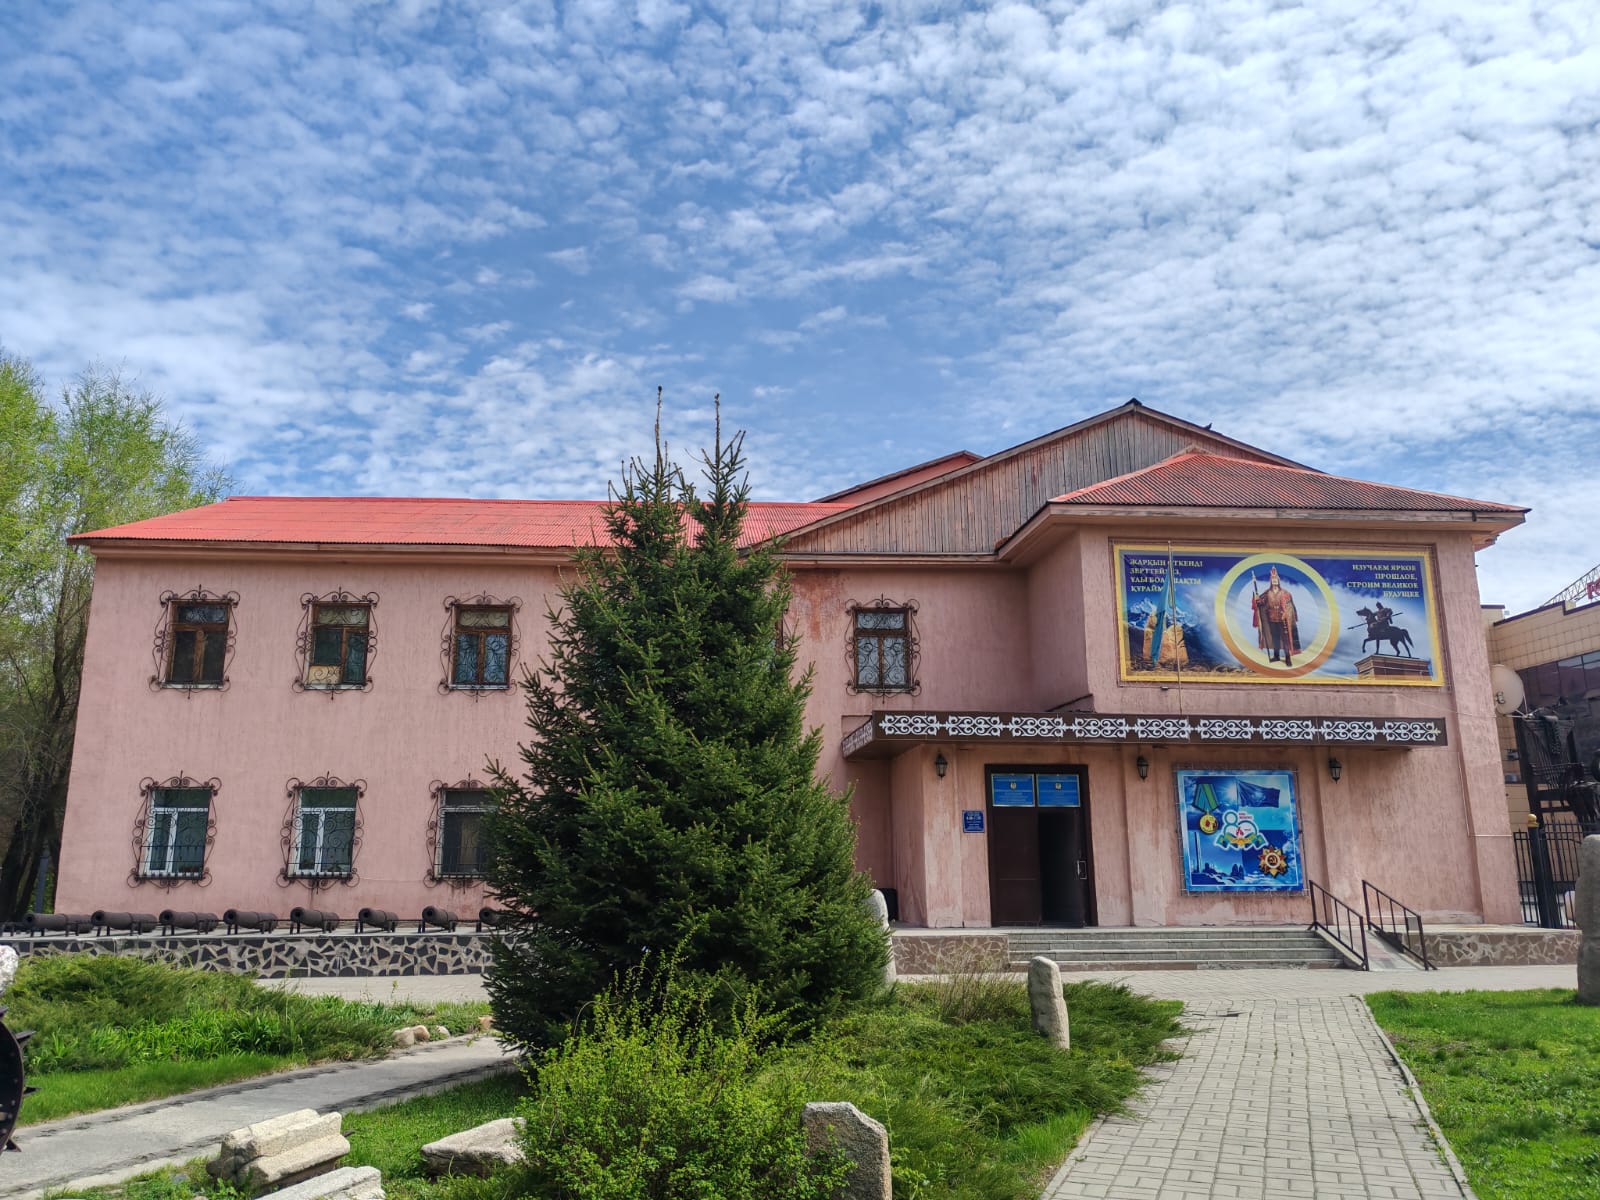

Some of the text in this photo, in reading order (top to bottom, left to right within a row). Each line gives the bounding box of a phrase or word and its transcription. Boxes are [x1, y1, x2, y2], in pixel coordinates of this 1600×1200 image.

[1129, 567, 1181, 577] ЗЕРТТЕЙЗ,
[1149, 577, 1202, 585] БОЛШАҚТЫ
[1375, 573, 1418, 581] ПРОШЛОЕ,
[1131, 584, 1177, 593] ҚҰРАЙМ
